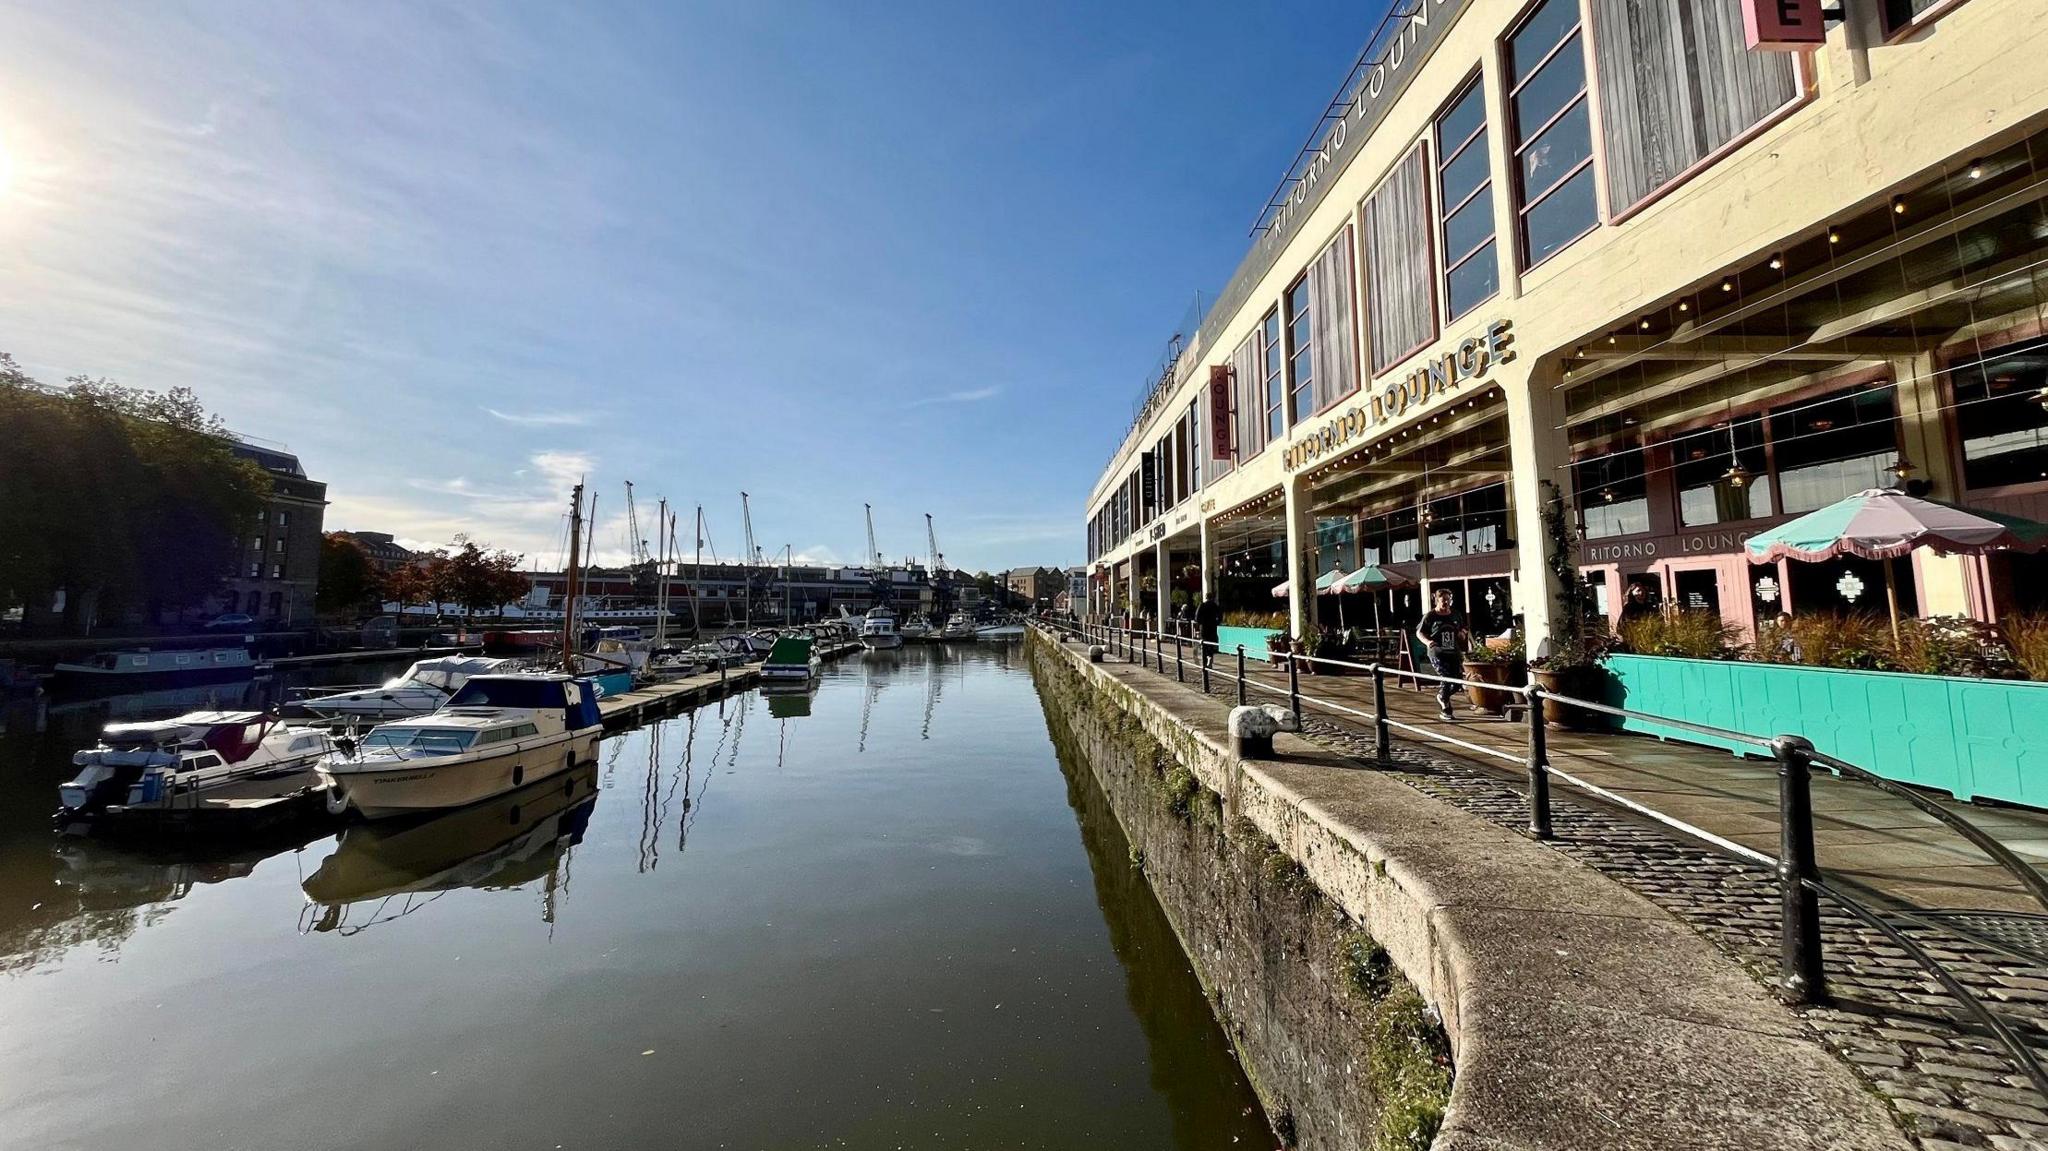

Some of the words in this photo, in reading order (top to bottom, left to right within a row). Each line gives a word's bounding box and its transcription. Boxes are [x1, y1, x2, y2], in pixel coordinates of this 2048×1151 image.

[1275, 120, 1347, 238] RITORNO
[1358, 0, 1447, 120] LOUN
[1283, 407, 1366, 472] RITORNO
[1371, 318, 1516, 425] LOUNGE
[1591, 542, 1656, 560] RITORNO
